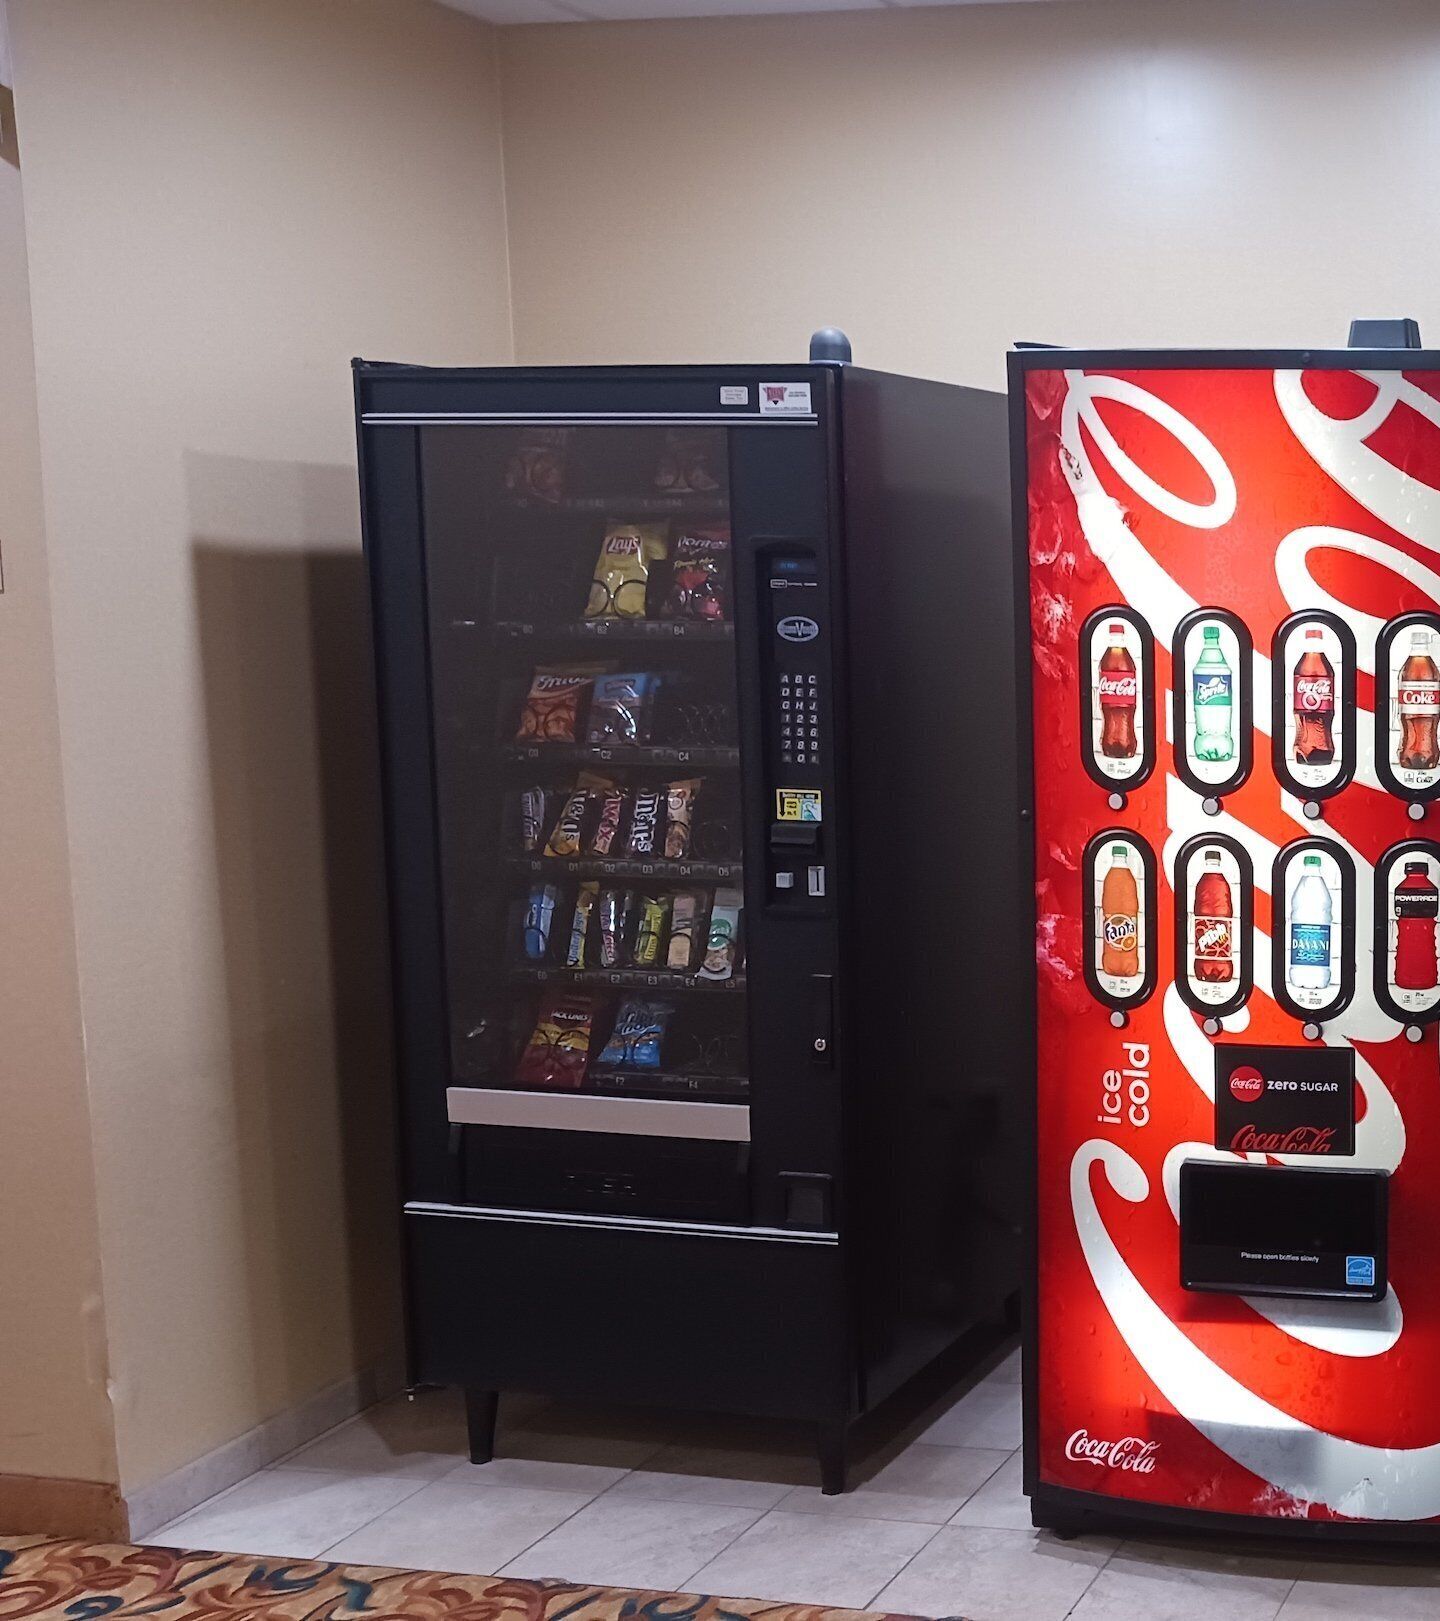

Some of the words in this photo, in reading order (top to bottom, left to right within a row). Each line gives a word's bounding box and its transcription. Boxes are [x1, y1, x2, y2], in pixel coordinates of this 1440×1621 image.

[1403, 690, 1435, 704] Coke
[678, 752, 689, 761] C4
[1122, 1042, 1150, 1127] cold
[1230, 1077, 1262, 1090] Coca-Cola
[1267, 1080, 1298, 1090] zero
[1300, 1082, 1338, 1092] SUGAR
[1098, 1070, 1122, 1124] ice
[1240, 1252, 1262, 1260] Please
[1279, 1253, 1300, 1261] bottles
[1300, 1254, 1320, 1263] slowly
[1064, 1428, 1161, 1474] Coca-Cola
